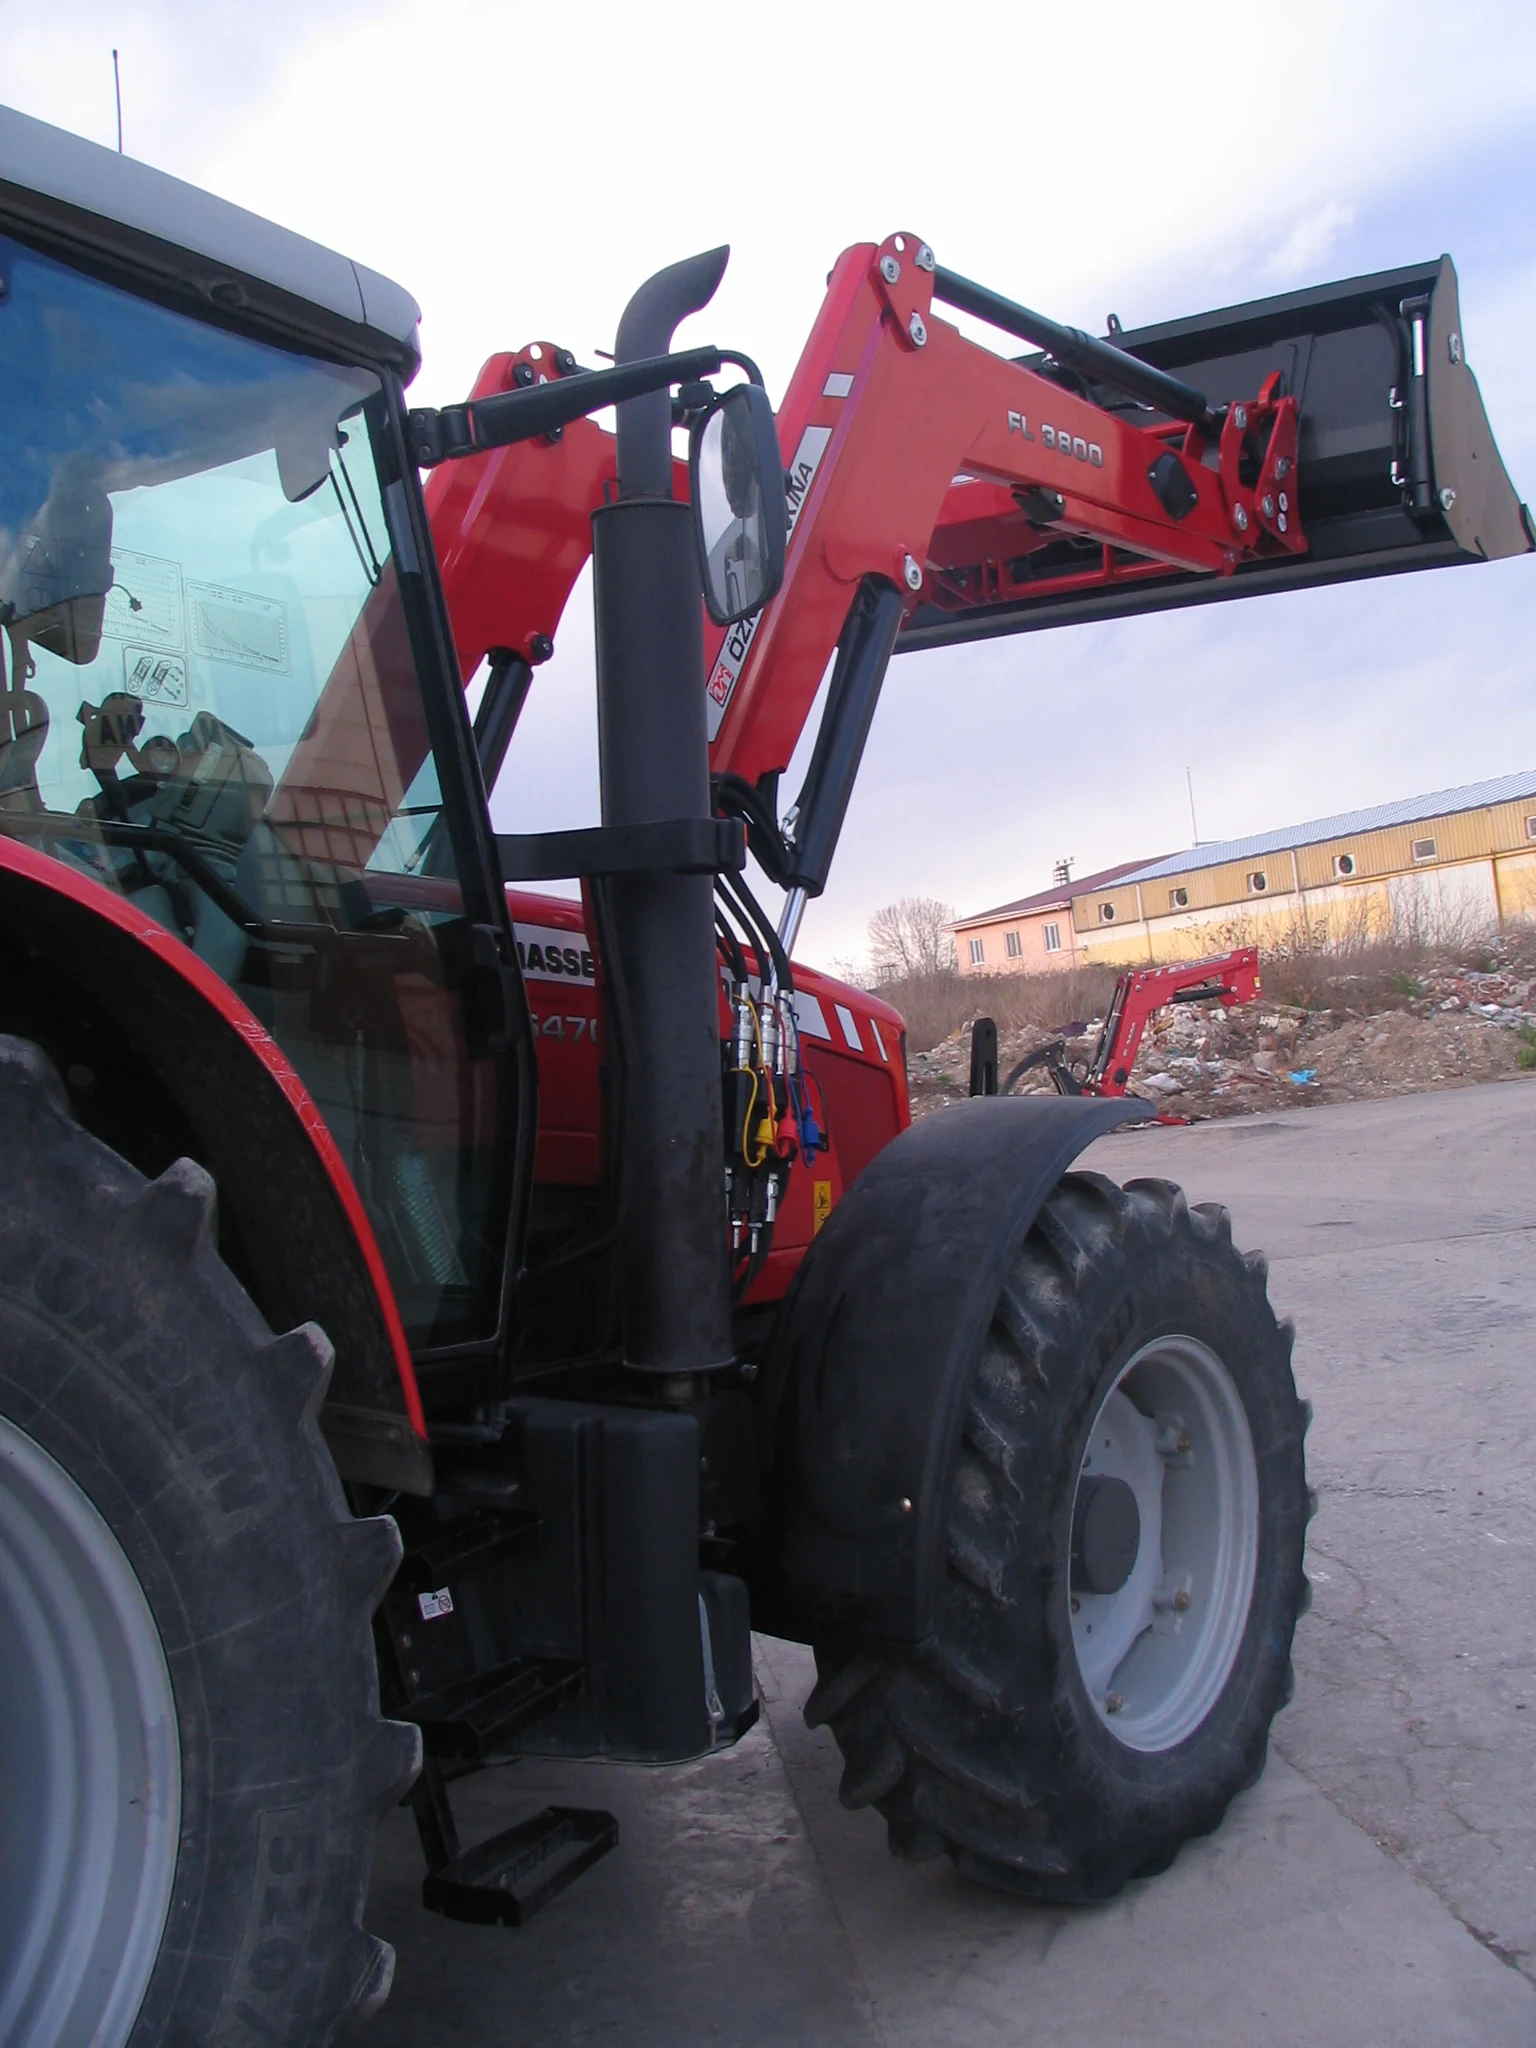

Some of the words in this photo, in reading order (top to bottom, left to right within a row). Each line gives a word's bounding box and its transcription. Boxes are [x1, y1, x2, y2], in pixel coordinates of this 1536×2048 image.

[1008, 410, 1034, 442] FL
[1041, 424, 1103, 468] 3800
[727, 616, 754, 662] ÖZ
